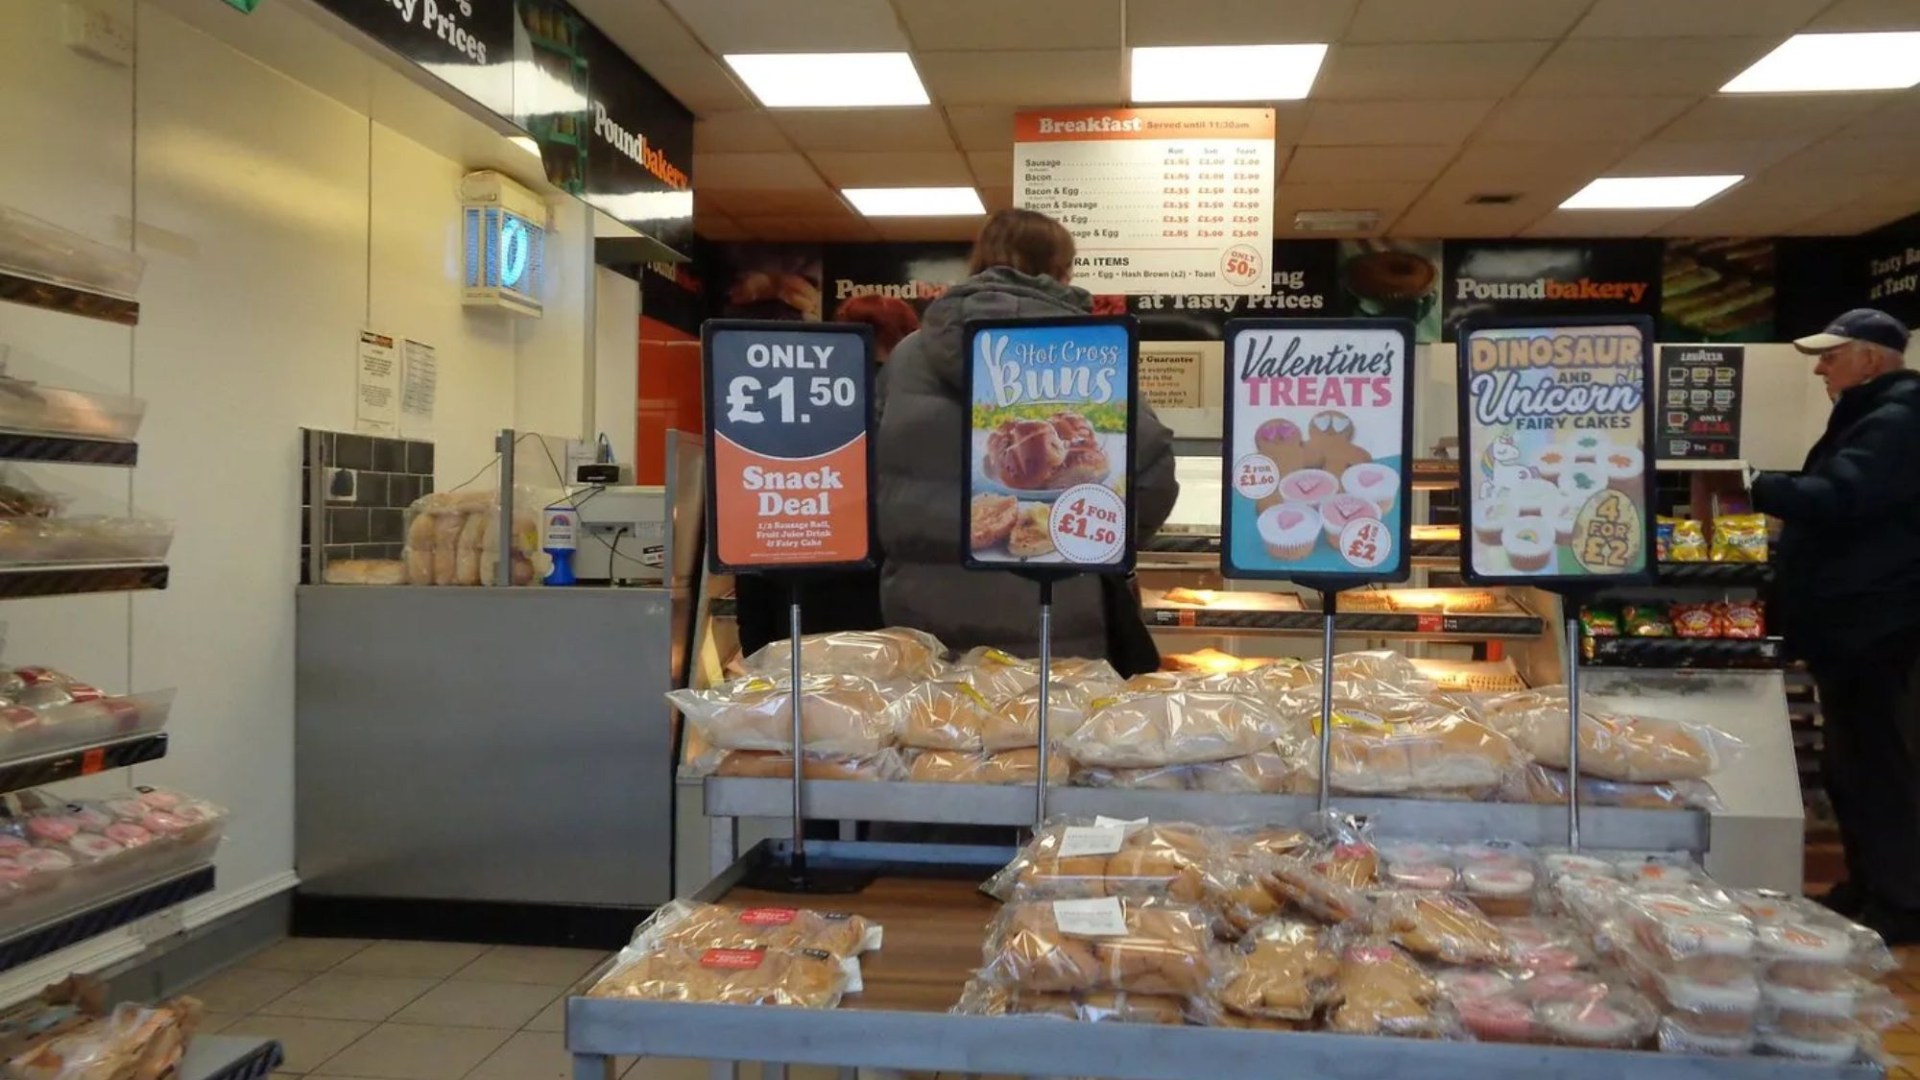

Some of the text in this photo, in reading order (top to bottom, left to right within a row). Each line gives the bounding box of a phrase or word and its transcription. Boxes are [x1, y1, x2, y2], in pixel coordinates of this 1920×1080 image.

[422, 0, 487, 65] Prices
[1039, 116, 1143, 133] Breakfast
[1147, 121, 1181, 129] Served
[1184, 120, 1206, 129] until
[1025, 159, 1061, 168] Sausage
[1025, 173, 1052, 181] Bacon
[1025, 187, 1052, 195] Bacon
[1053, 187, 1060, 195] &
[1062, 187, 1080, 196] Egg
[1025, 201, 1052, 209] Bacon
[1053, 201, 1060, 209] &
[1062, 201, 1098, 210] Sausage
[1062, 215, 1069, 223] &
[1071, 215, 1088, 224] Egg
[1071, 229, 1091, 238] sage
[1093, 229, 1100, 237] &
[1102, 228, 1119, 239] Egg
[1094, 257, 1130, 266] ITEMS
[1231, 250, 1256, 263] ONLY
[1098, 271, 1114, 279] Egg
[1194, 270, 1216, 278] Toast
[836, 279, 948, 299] Poundba
[1456, 278, 1648, 303] Poundbakery
[1138, 291, 1324, 313] at Tasty Prices
[746, 343, 835, 369] ONLY
[1015, 340, 1120, 364] Hot Cross
[1240, 335, 1395, 381] Valentine's
[1471, 335, 1643, 372] DINOSAUR
[985, 348, 1116, 407] Buns
[1557, 371, 1592, 385] AND
[726, 375, 856, 424] £1.50
[1242, 376, 1393, 407] TREATS
[1471, 370, 1642, 426] Unicorn
[1516, 415, 1632, 430] FAIRY CAKES
[742, 465, 843, 490] Snack
[1242, 464, 1272, 473] 2 FOR
[758, 491, 830, 516] Deal
[1069, 497, 1118, 524] 4 FOR
[1595, 495, 1621, 522] 4
[756, 529, 832, 539] Fruit Juice Drink
[774, 521, 809, 530] Sausage
[1058, 512, 1117, 545] £1.50
[1358, 523, 1371, 541] 4
[1588, 520, 1630, 538] FOR
[775, 539, 799, 548] Fairy
[800, 538, 823, 546] Cake
[1348, 539, 1377, 562] £2
[1583, 534, 1631, 567] £2
